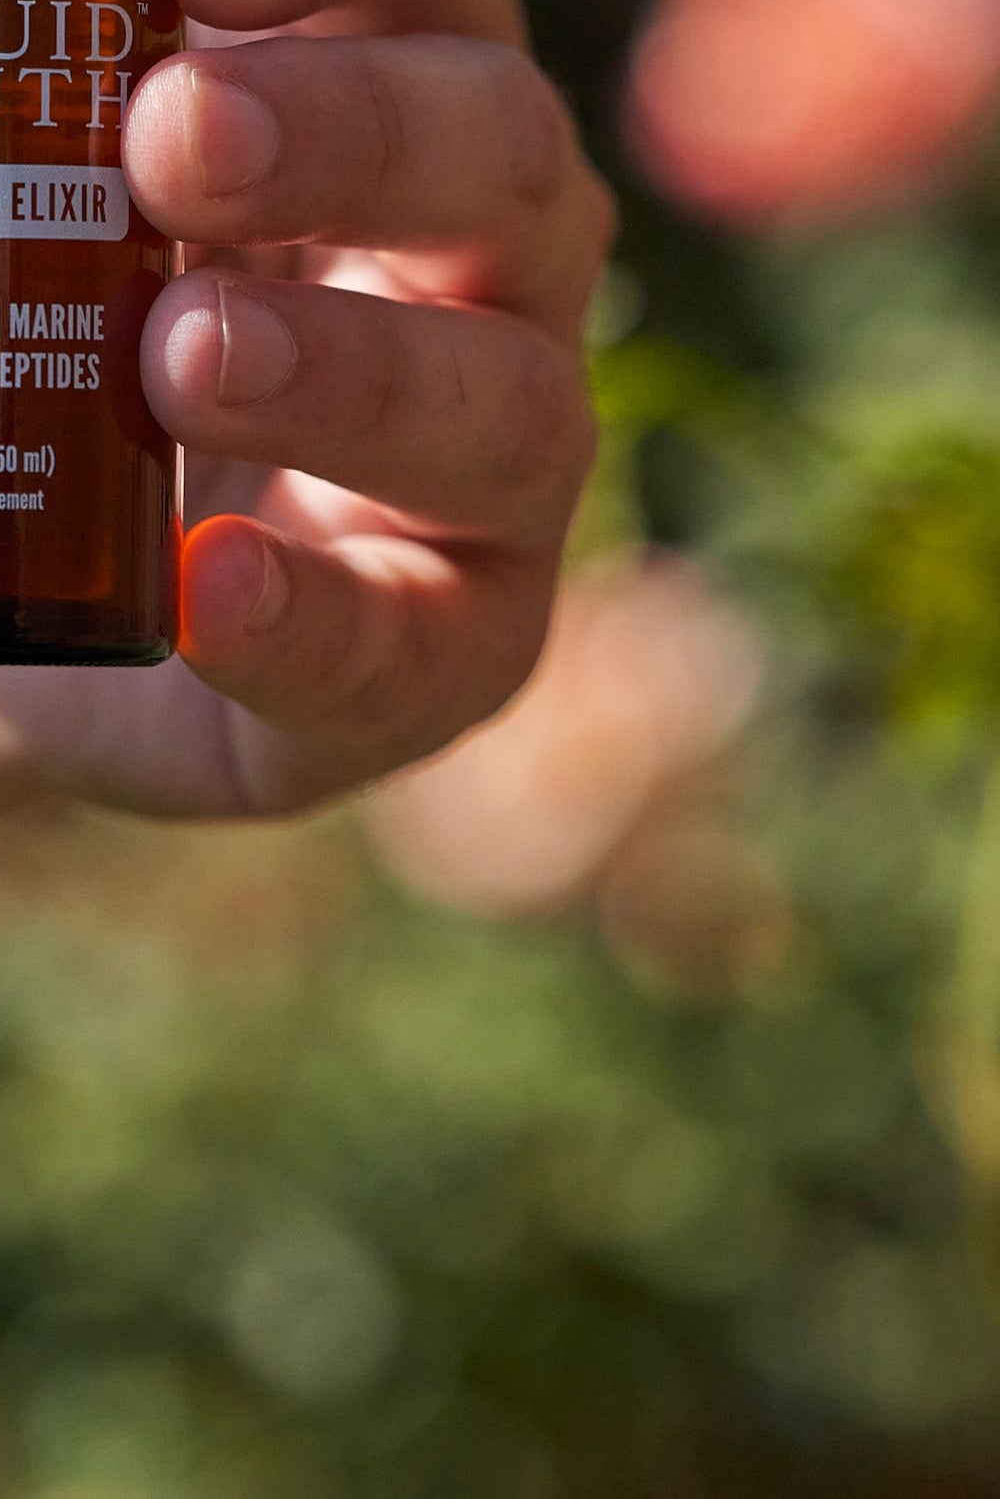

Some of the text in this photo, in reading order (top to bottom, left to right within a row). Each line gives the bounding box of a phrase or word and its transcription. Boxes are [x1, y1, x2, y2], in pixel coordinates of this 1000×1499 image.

[11, 182, 107, 223] ELIXIR
[9, 303, 105, 341] MARINE
[23, 444, 56, 478] ml)
